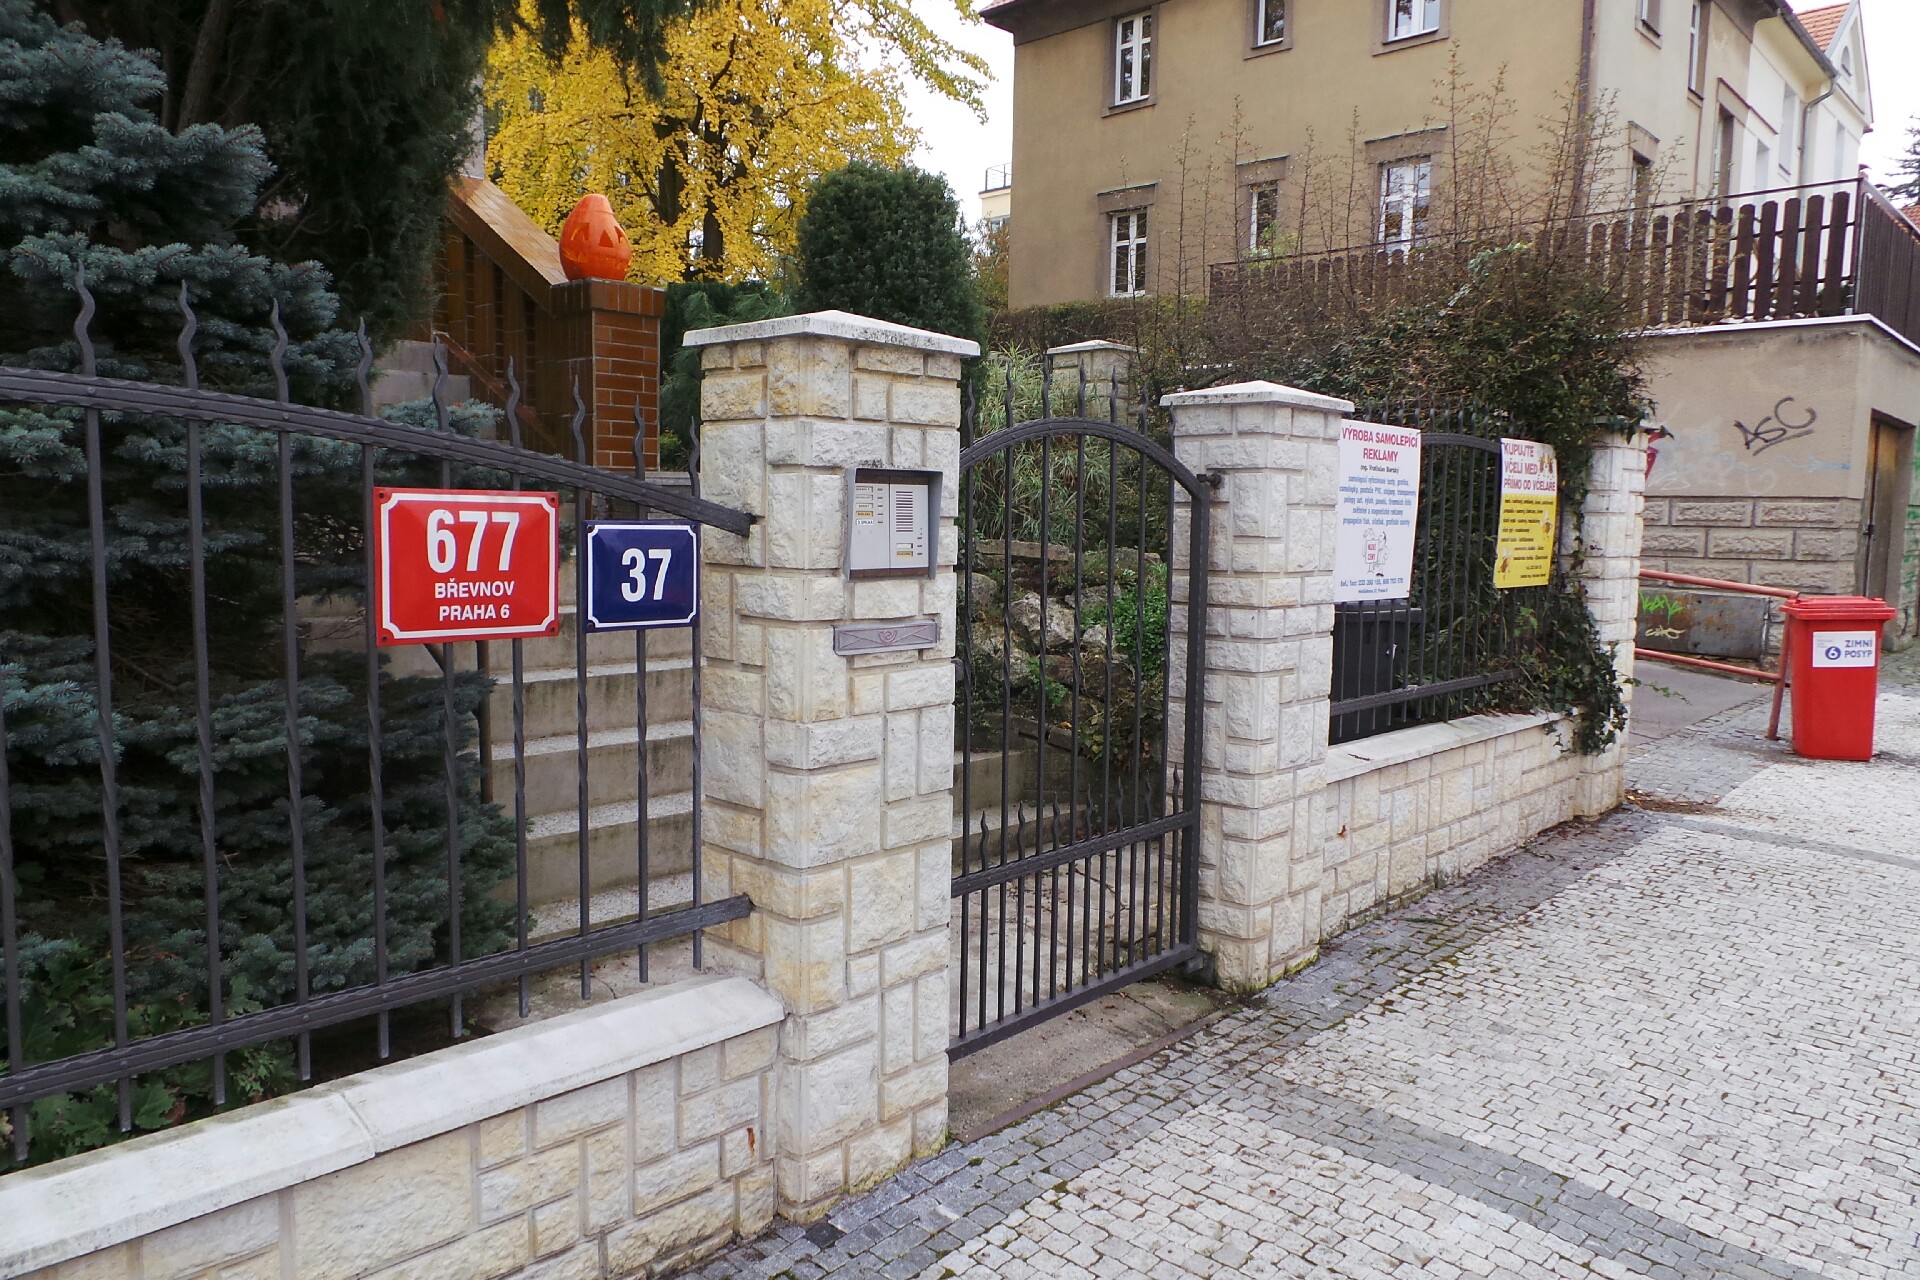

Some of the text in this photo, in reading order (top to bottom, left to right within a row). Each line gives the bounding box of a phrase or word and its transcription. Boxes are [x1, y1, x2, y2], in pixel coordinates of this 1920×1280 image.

[1342, 425, 1418, 448] VÝROBA SAMOLEPÍCÍ
[1363, 448, 1398, 462] REKLAMY
[1504, 443, 1534, 457] KUPUJTE
[1504, 458, 1538, 475] VČELÍ MED
[1523, 480, 1531, 490] OD
[426, 508, 520, 574] 677
[620, 548, 672, 603] 37
[434, 577, 515, 599] BŘEVNOV
[439, 604, 510, 622] PRAHA 6
[1845, 638, 1873, 648] ZIMNÍ
[1828, 648, 1872, 659] 6 POSYP
